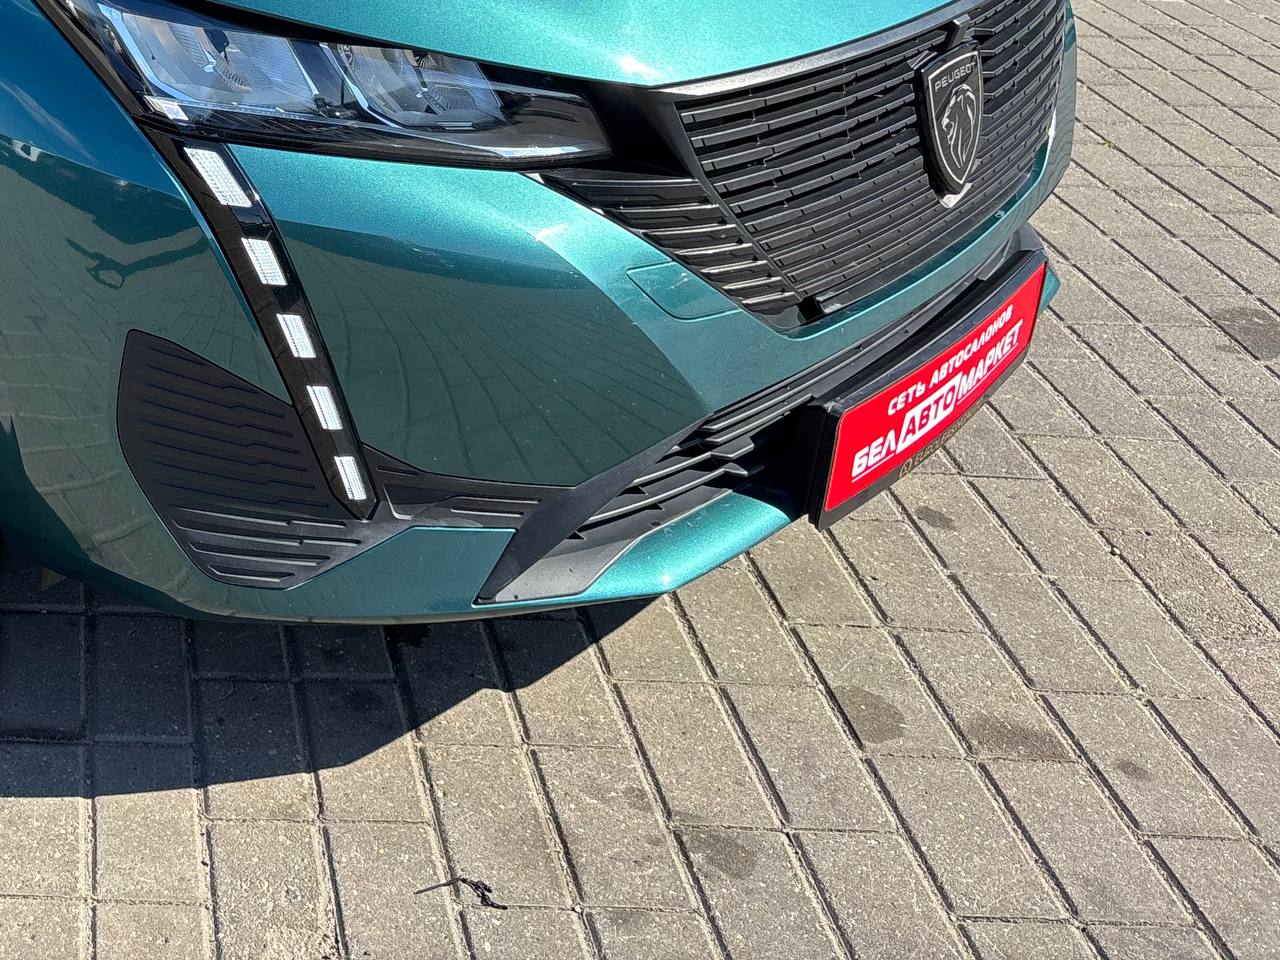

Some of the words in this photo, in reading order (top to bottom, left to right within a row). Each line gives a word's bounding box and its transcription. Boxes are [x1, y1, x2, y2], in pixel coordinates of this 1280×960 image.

[934, 61, 976, 92] PEUGEOT
[887, 382, 926, 416] СЕТЬ
[929, 304, 1013, 388] АВТОСАЛОНОВ
